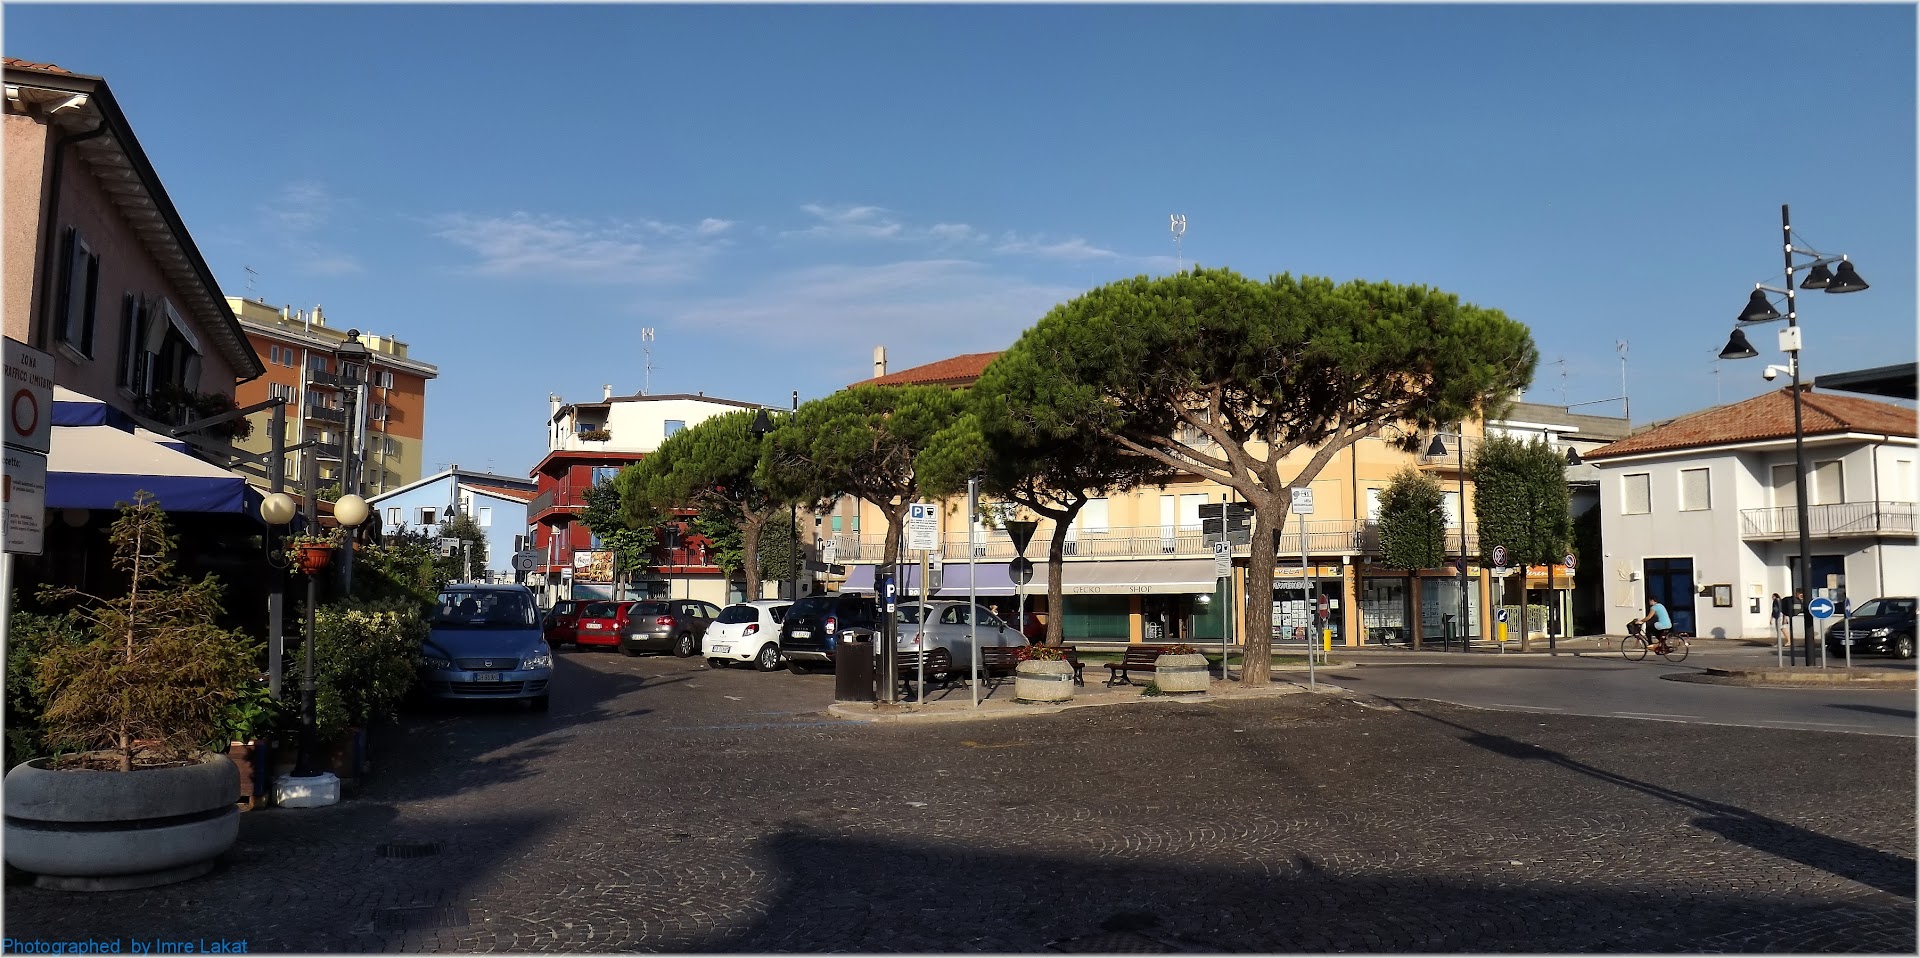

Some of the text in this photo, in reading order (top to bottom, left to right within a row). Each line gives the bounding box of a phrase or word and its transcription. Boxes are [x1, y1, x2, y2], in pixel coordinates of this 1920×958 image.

[21, 353, 37, 369] ZONA
[29, 373, 53, 391] LIMITATO
[914, 507, 921, 517] P
[886, 584, 895, 597] P
[1073, 585, 1152, 594] GECKO SHOP
